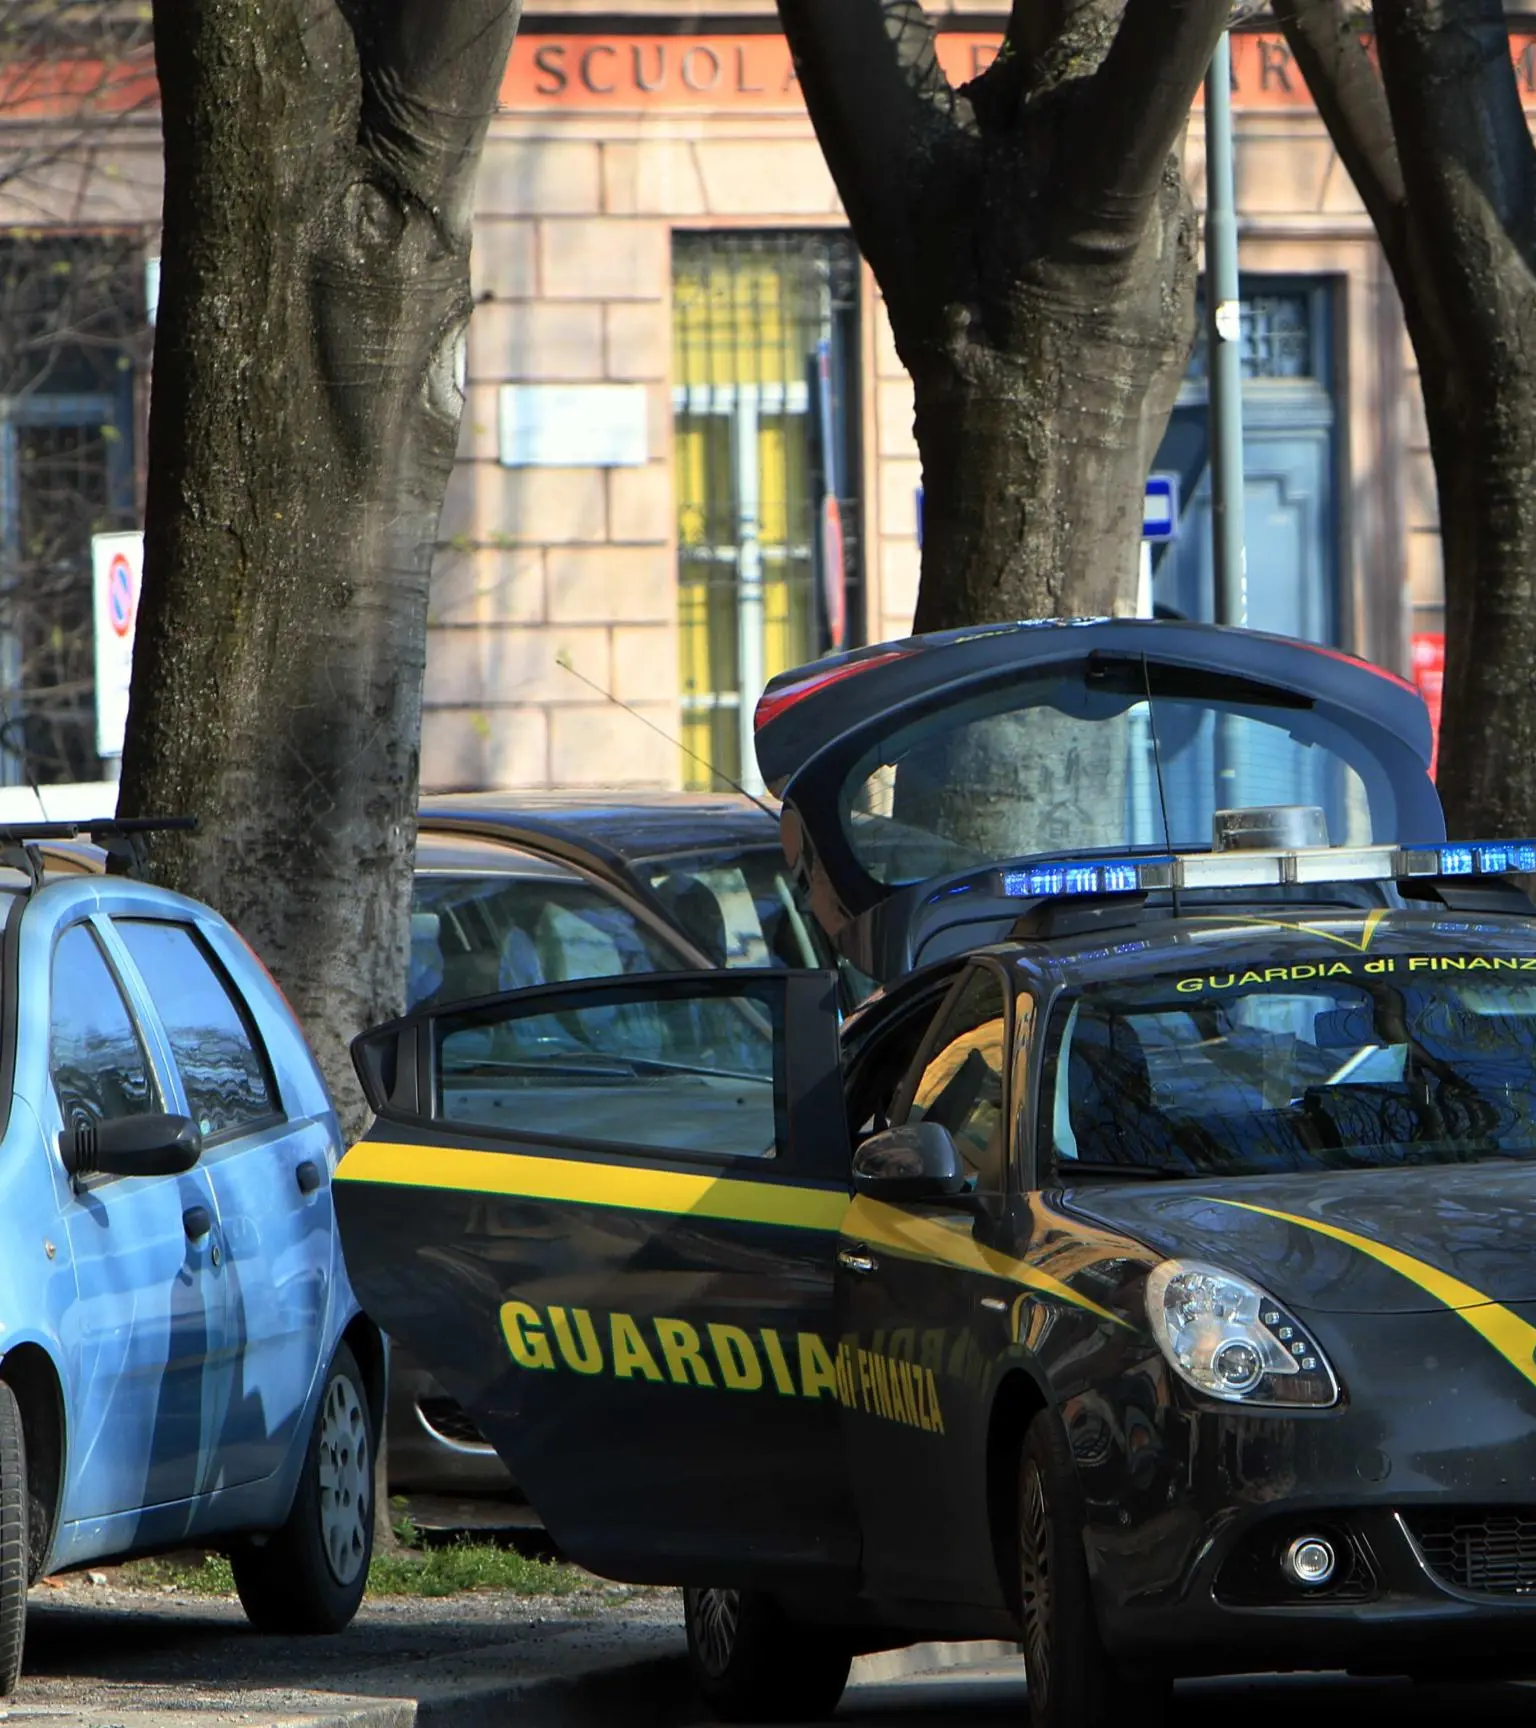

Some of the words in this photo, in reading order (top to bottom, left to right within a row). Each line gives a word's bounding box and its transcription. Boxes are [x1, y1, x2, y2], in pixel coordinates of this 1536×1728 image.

[1176, 962, 1352, 994] GUARDIA
[1364, 957, 1395, 974] di
[499, 1300, 839, 1400] GUARDIA
[836, 1341, 857, 1410] di
[857, 1347, 945, 1435] FINANZA
